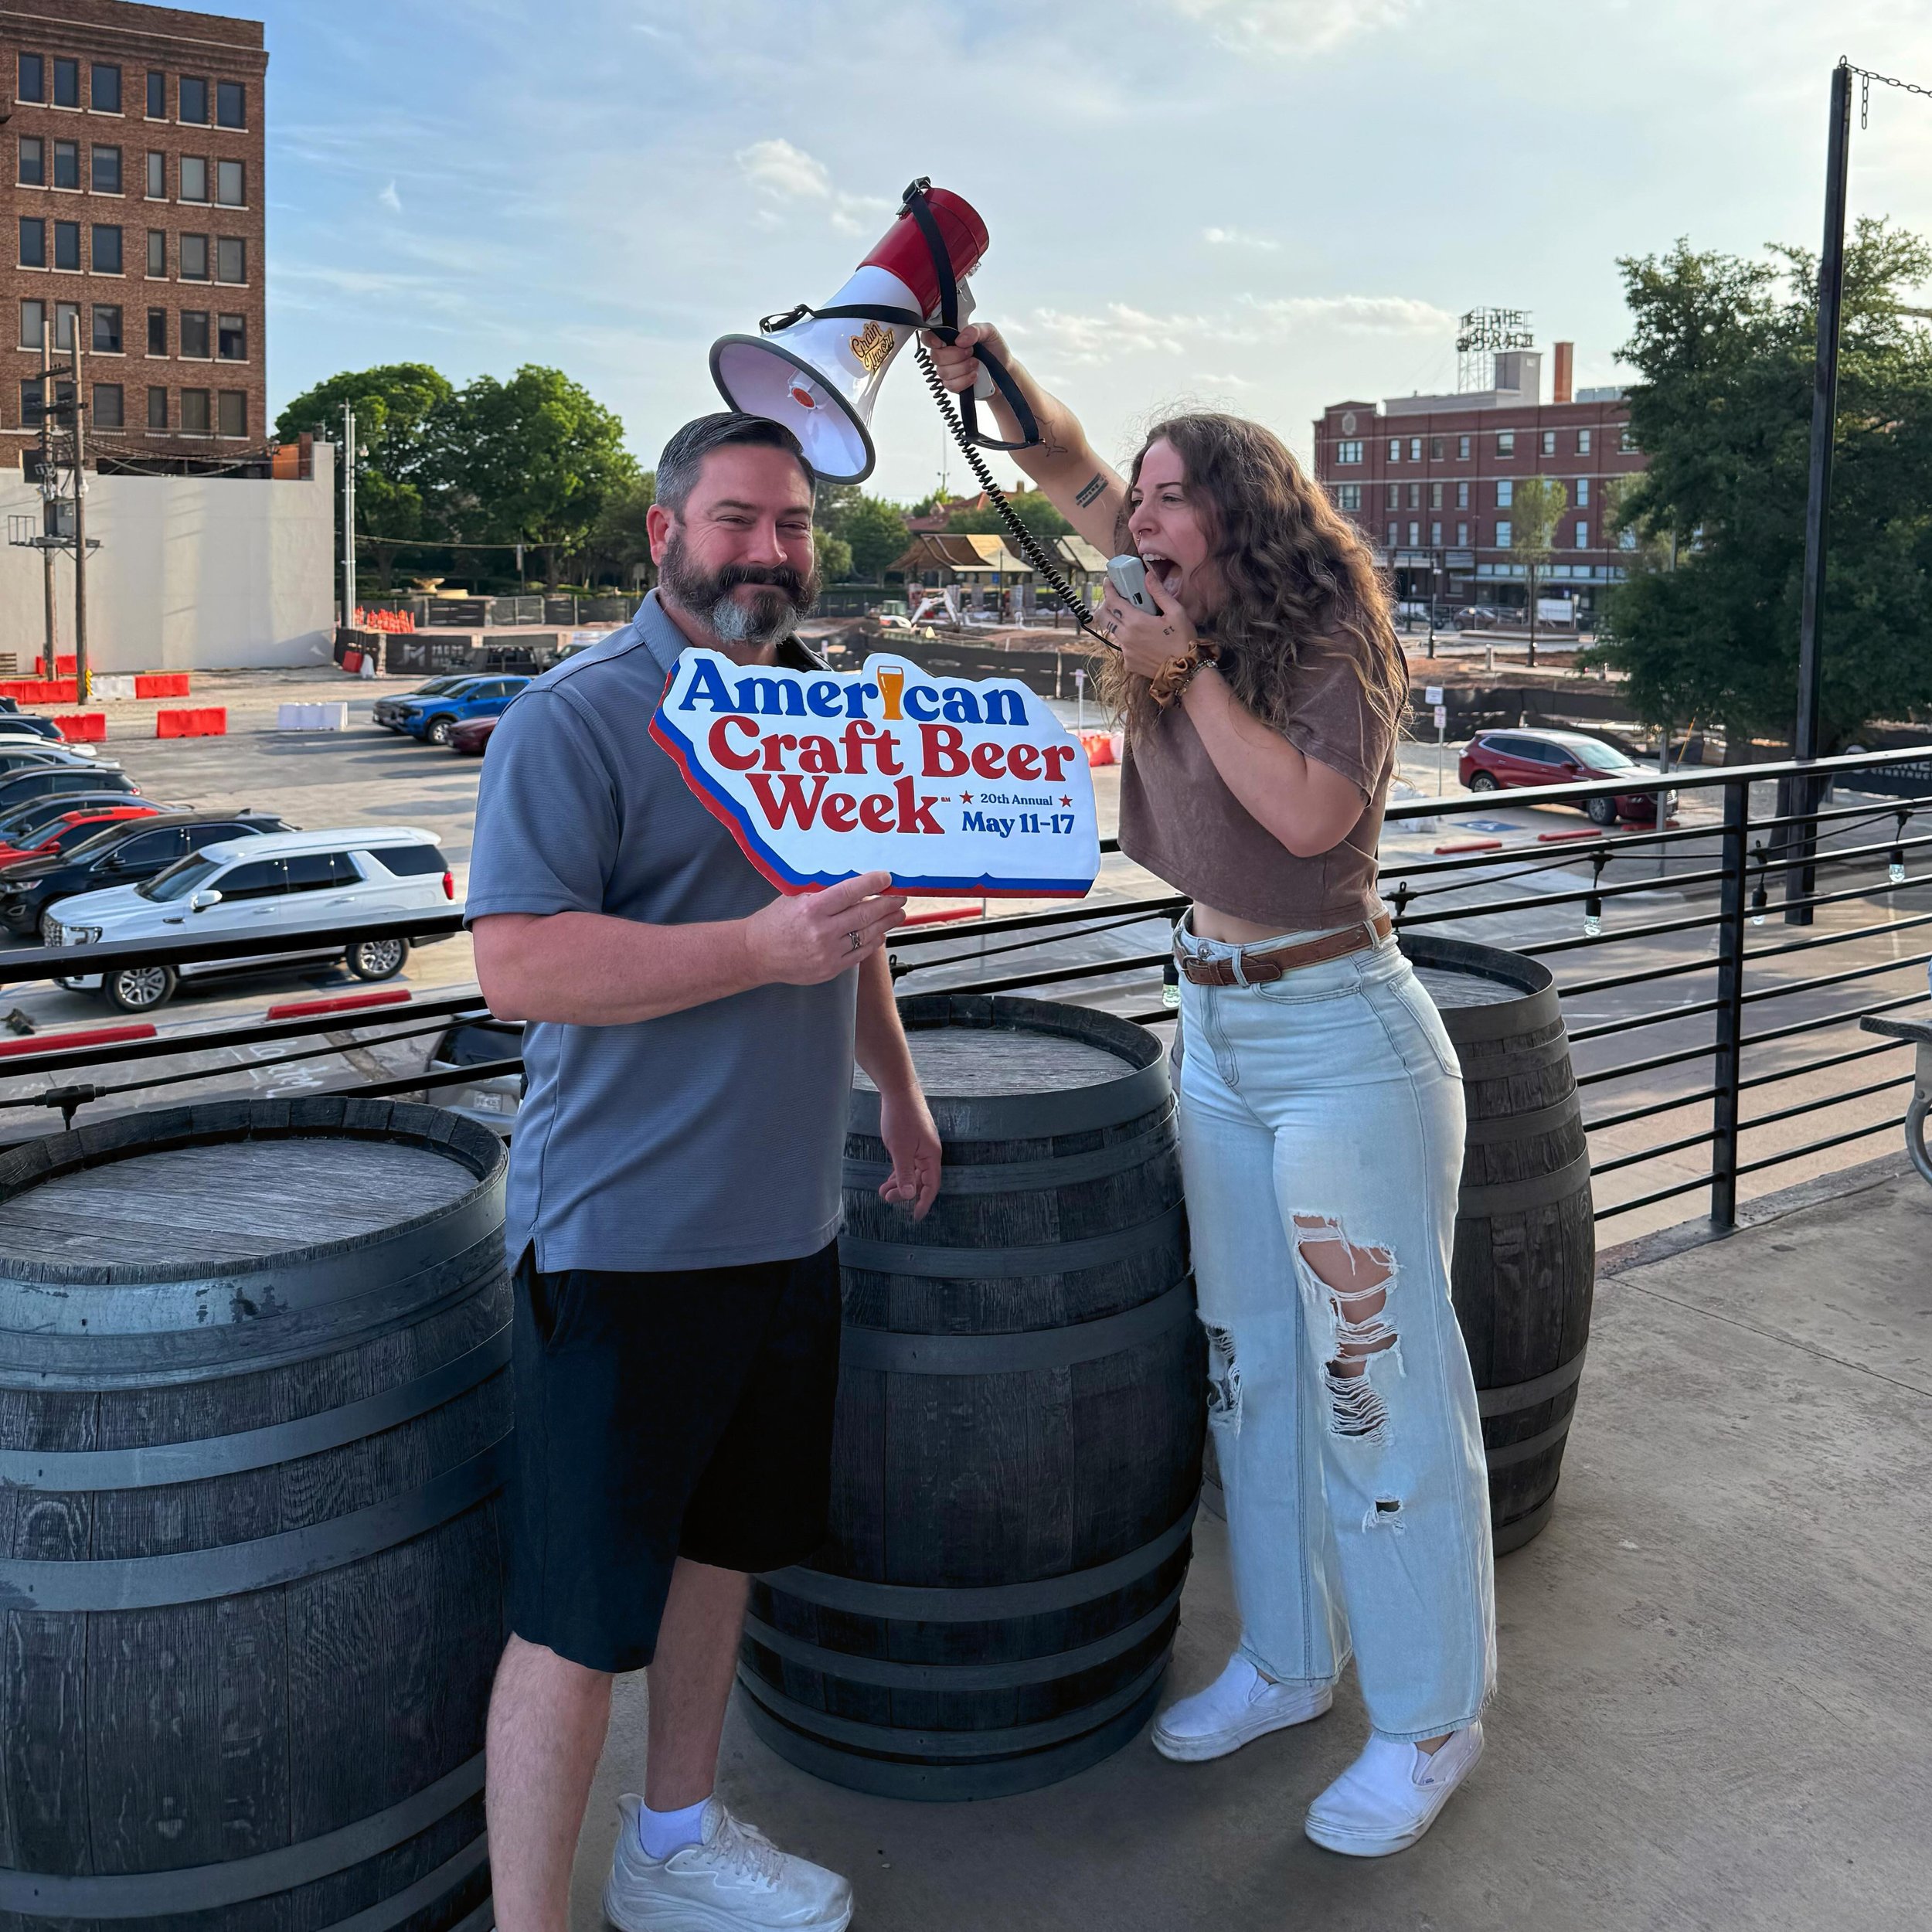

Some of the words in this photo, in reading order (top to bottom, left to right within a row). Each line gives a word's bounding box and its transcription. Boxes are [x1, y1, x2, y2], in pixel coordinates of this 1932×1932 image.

[852, 323, 883, 358] Grain
[708, 715, 904, 776] Craft
[918, 723, 1075, 782] Beer
[1870, 767, 1932, 780] CONSTRUC
[745, 773, 945, 834] Week
[981, 793, 1009, 804] 20th
[1012, 794, 1053, 805] Annual
[962, 811, 1015, 838] May
[1019, 813, 1075, 834] 11-17
